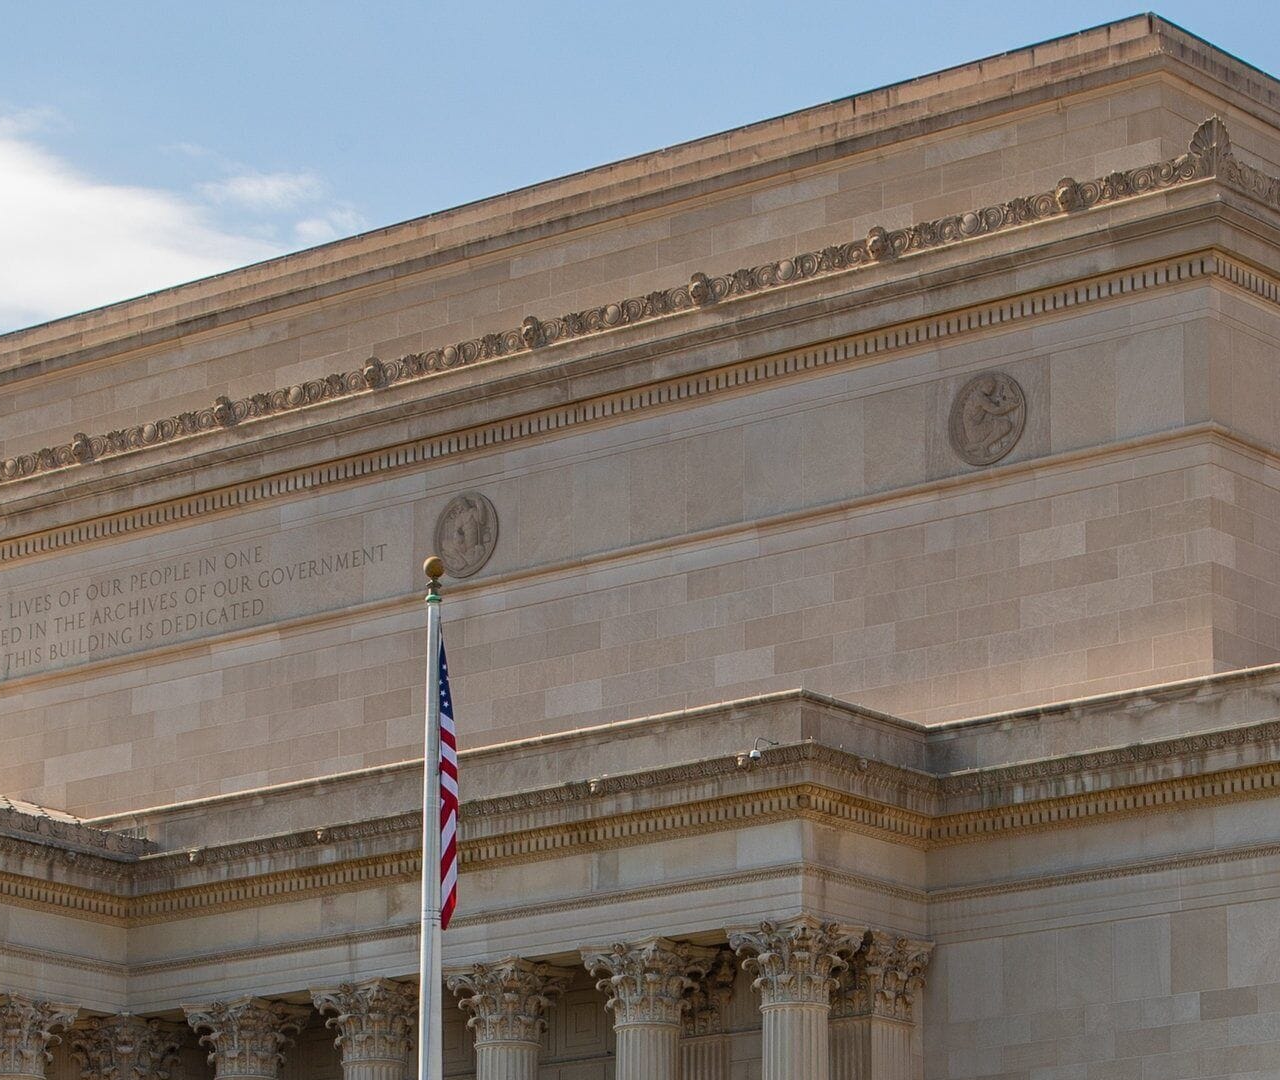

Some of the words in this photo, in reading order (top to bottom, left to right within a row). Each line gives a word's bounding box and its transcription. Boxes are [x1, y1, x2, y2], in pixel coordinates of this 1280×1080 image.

[9, 594, 52, 619] LIVES
[58, 587, 80, 608] OF
[86, 578, 124, 601] OUR
[130, 562, 191, 592] PEOPLE
[198, 556, 217, 577] IN
[224, 545, 263, 570] ONE
[28, 620, 47, 640] IN
[54, 611, 86, 634] THE
[92, 591, 178, 626] ARCHIVES
[184, 584, 207, 604] OF
[213, 575, 252, 598] OUR
[257, 543, 388, 589] GOVERNMENT
[4, 647, 42, 669] THIS
[49, 627, 133, 661] BUILDING
[139, 622, 154, 641] IS
[161, 598, 264, 637] DEDICATED
